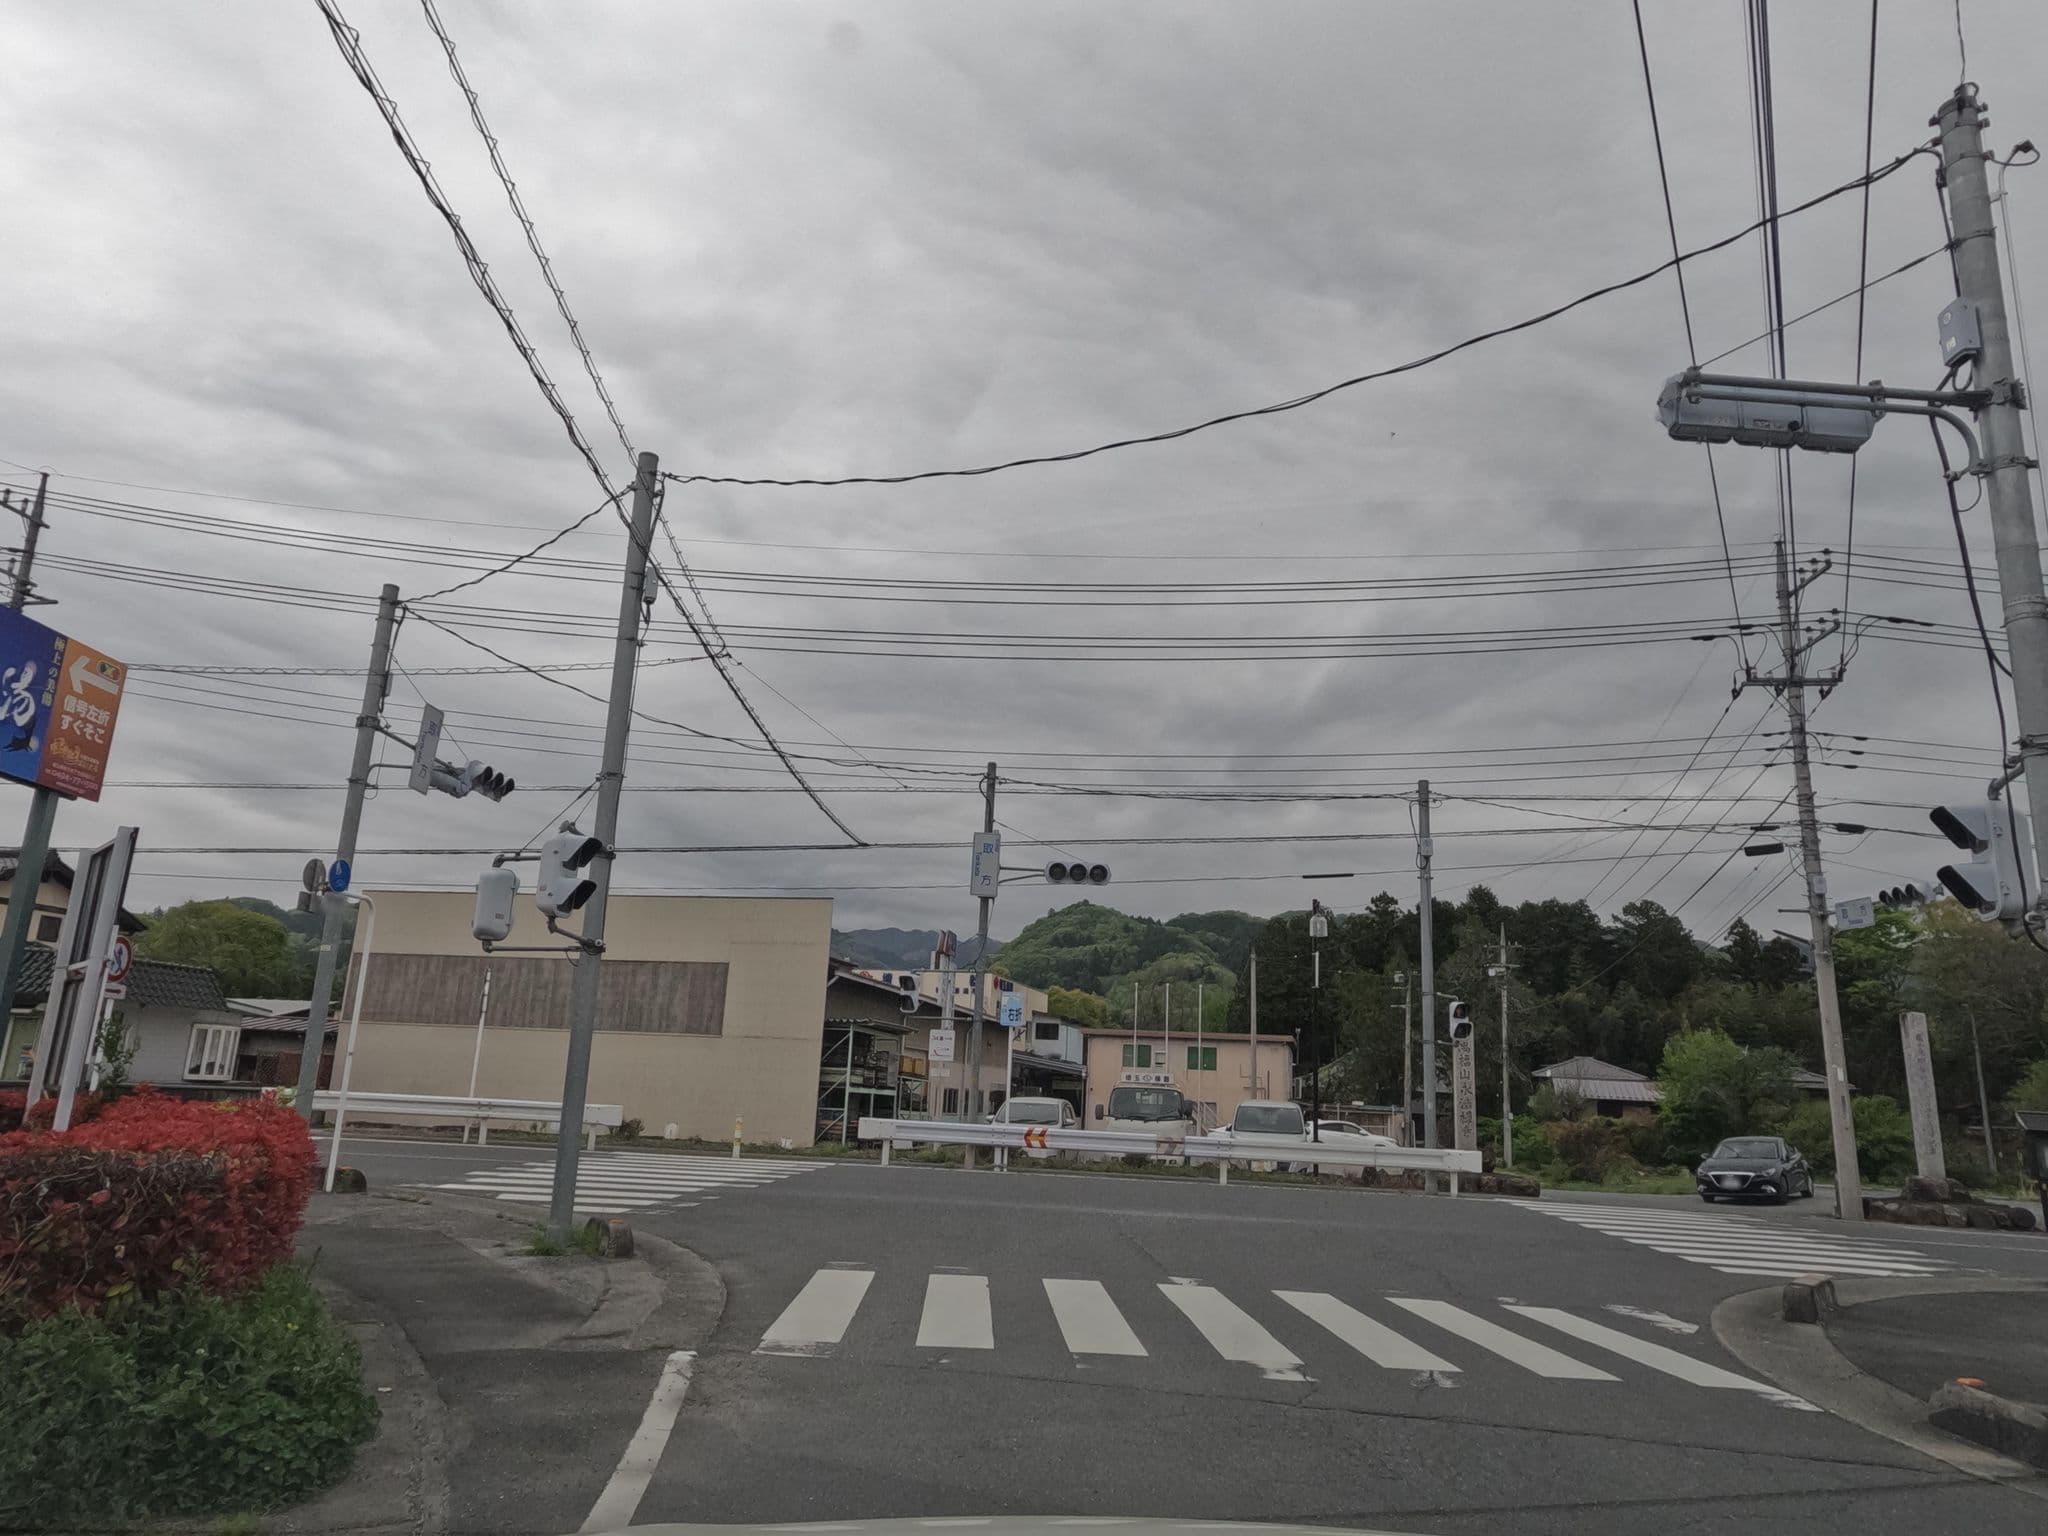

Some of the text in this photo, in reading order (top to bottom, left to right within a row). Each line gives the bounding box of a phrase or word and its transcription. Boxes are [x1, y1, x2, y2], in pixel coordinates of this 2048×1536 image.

[64, 695, 111, 726] 信号左折
[61, 715, 105, 744] すぐそこ
[981, 842, 994, 887] 取方
